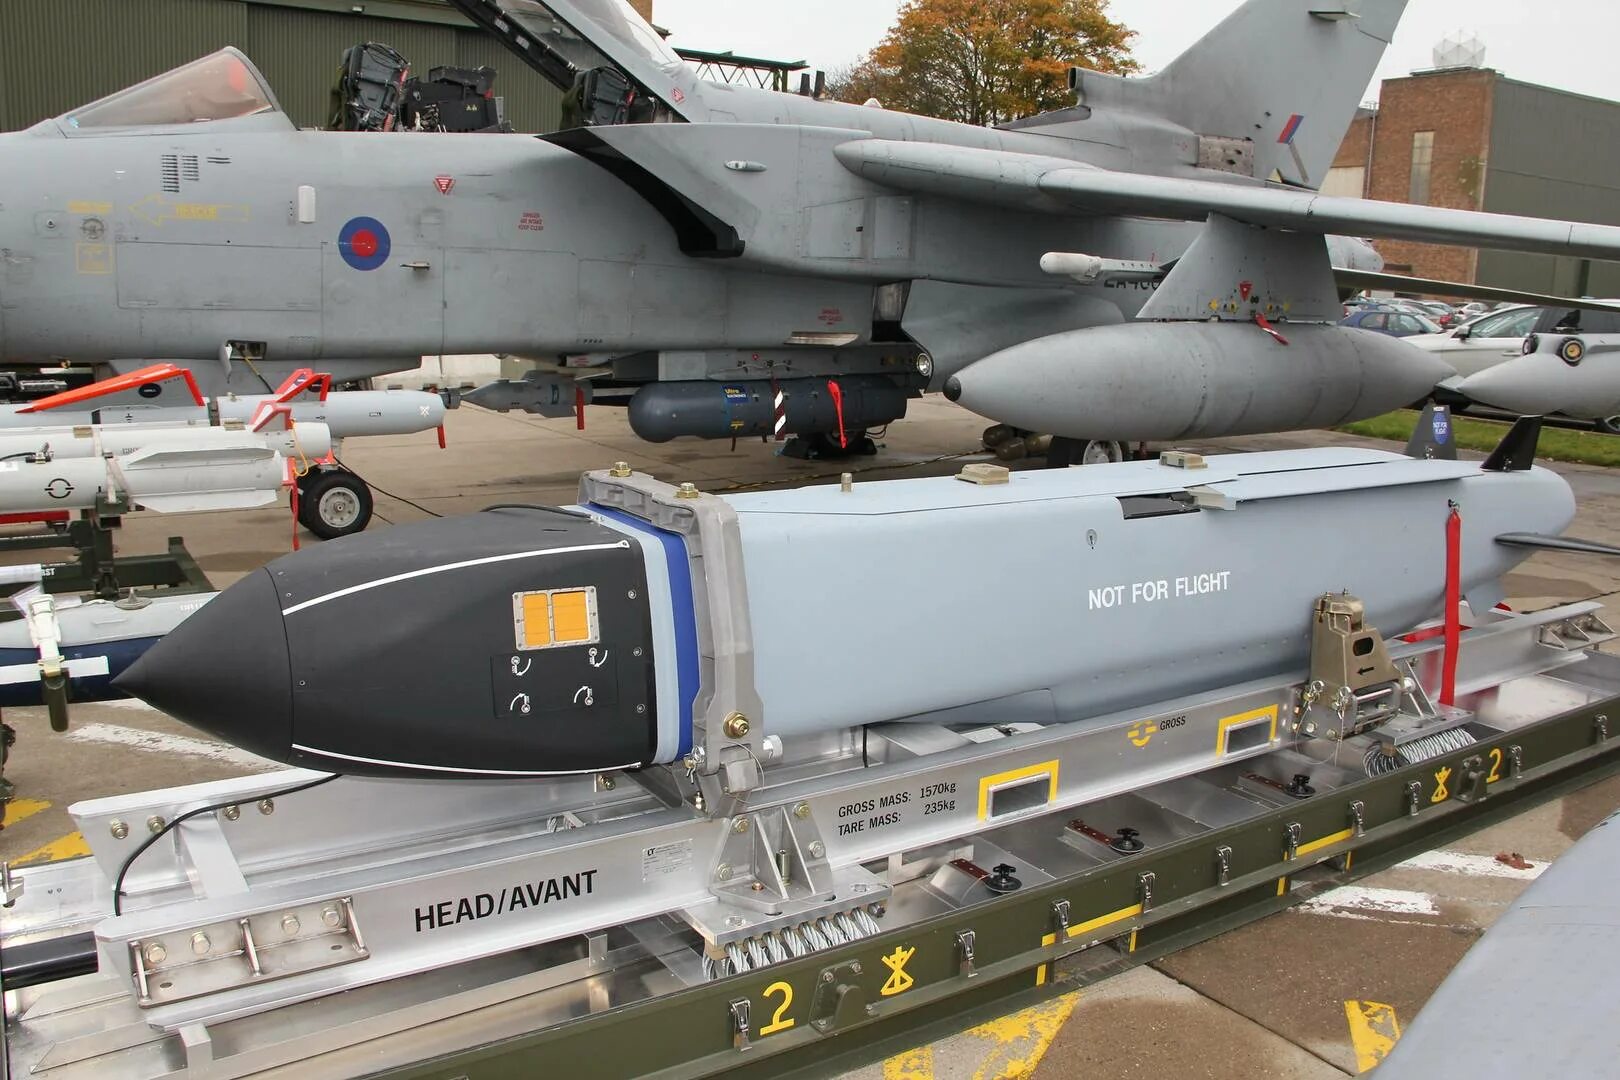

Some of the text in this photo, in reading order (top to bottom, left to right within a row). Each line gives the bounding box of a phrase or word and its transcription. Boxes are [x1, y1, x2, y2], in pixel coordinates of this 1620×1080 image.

[1088, 571, 1231, 610] NOT FOR FLIGHT
[1160, 716, 1186, 730] GROSS
[1486, 748, 1501, 783] 2
[838, 782, 957, 818] GROSS MASS: 1570kg
[838, 800, 956, 836] TARE MASS: 235kg
[415, 869, 598, 932] HEAD/AVANT
[759, 981, 795, 1036] 2
